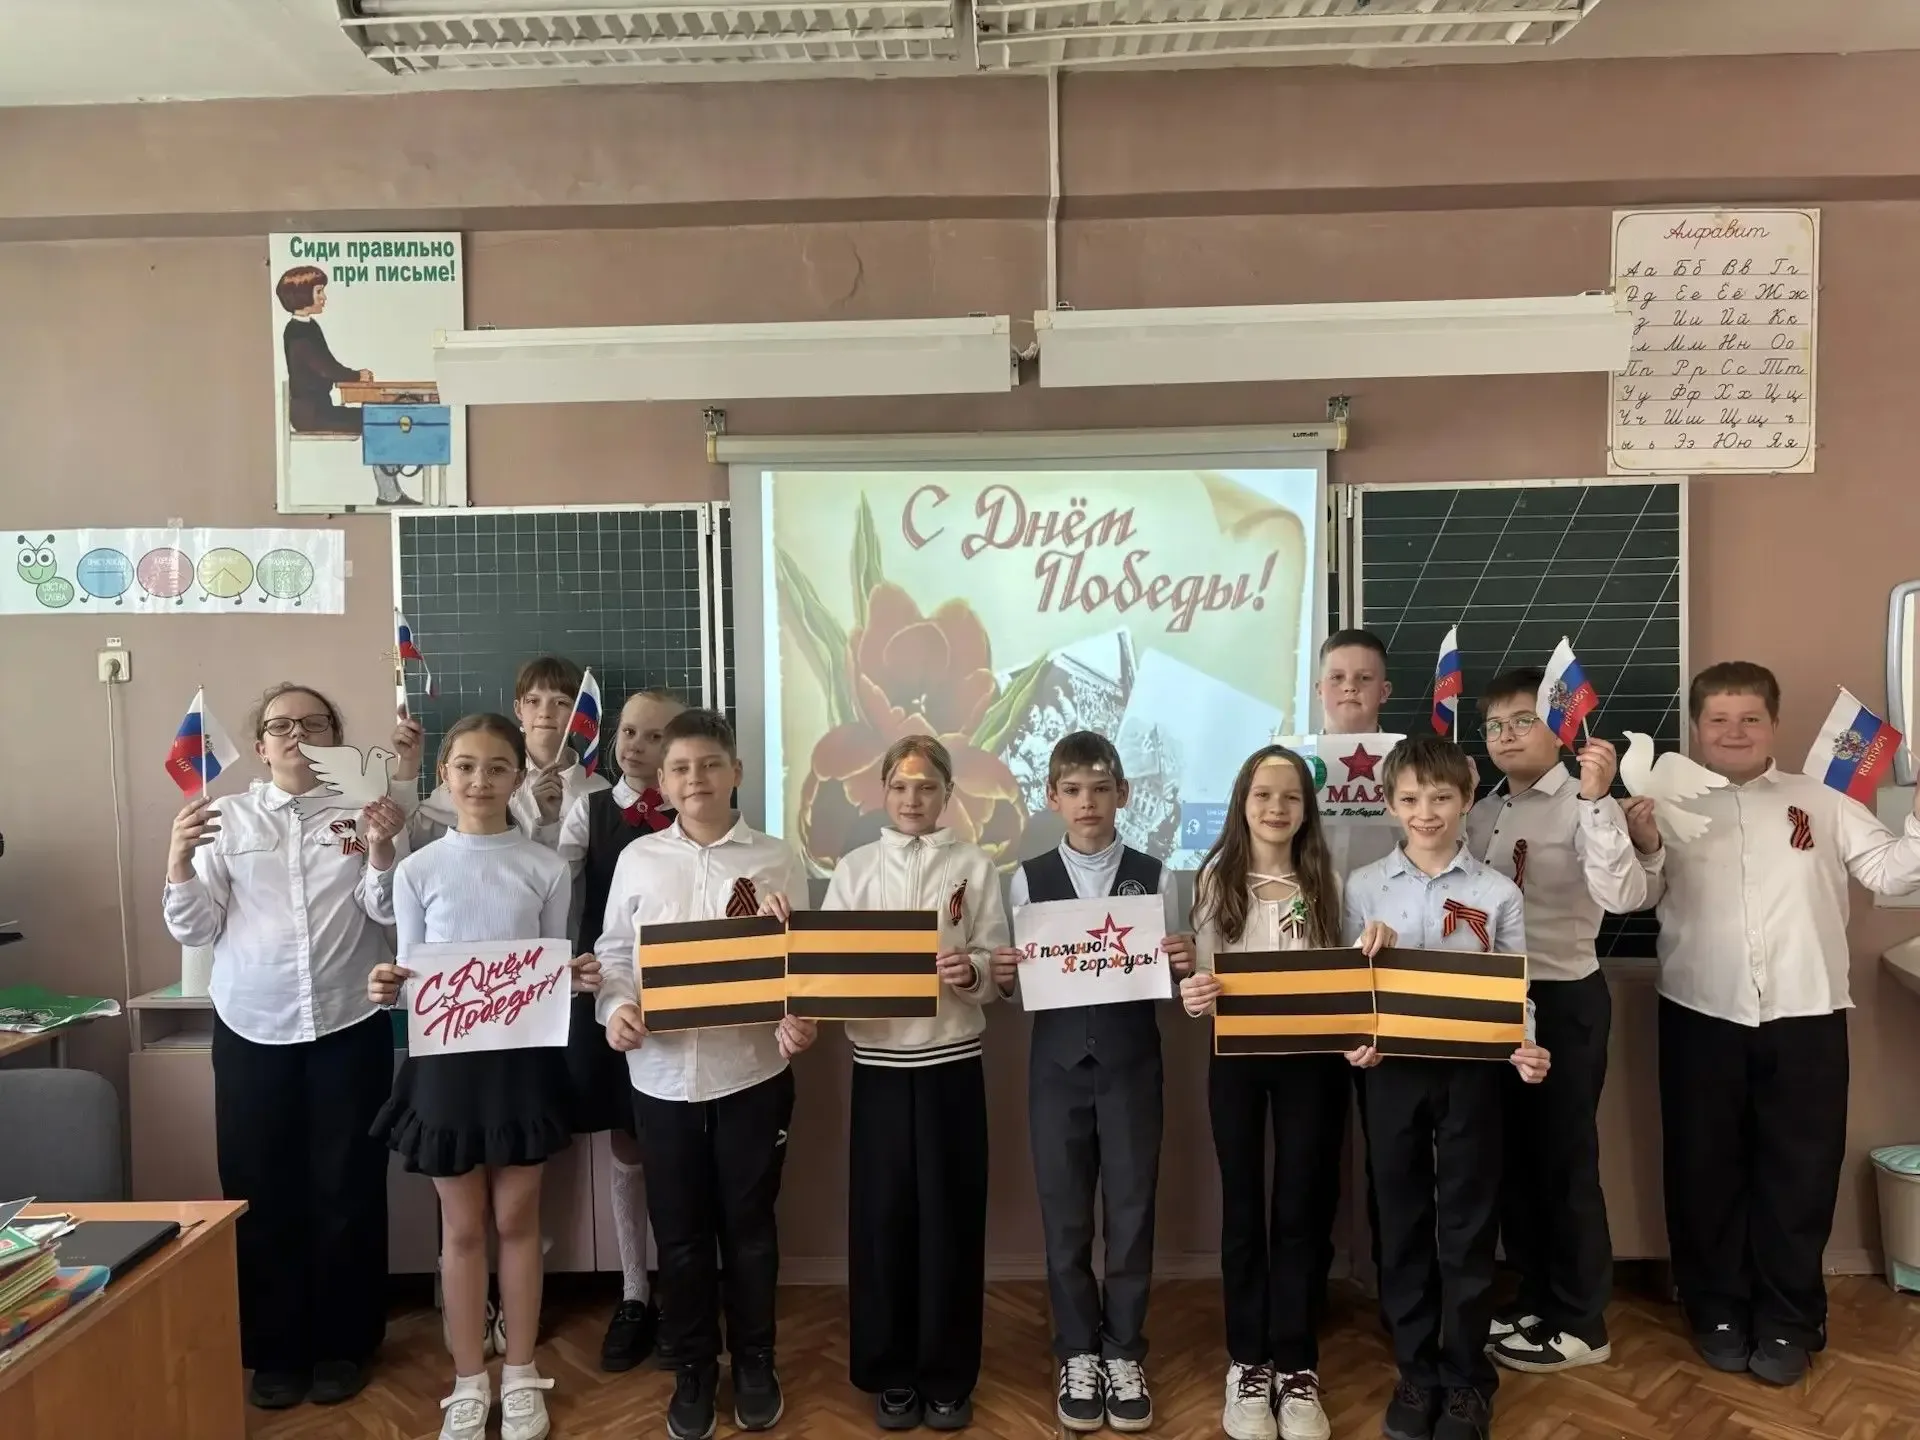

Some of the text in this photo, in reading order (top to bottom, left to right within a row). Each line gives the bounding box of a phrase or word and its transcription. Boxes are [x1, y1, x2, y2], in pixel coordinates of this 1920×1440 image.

[1664, 218, 1771, 249] Алфавит
[290, 236, 455, 263] Сиди правильно
[333, 260, 456, 287] при письме!
[901, 482, 1138, 560] С Днём
[1034, 549, 1280, 633] Победы!
[1325, 784, 1385, 803] МАЯ
[1022, 935, 1108, 961] Я помню!
[1061, 947, 1159, 977] Я горжусь!
[415, 945, 544, 1016] С Днём
[423, 965, 565, 1046] Победы!
